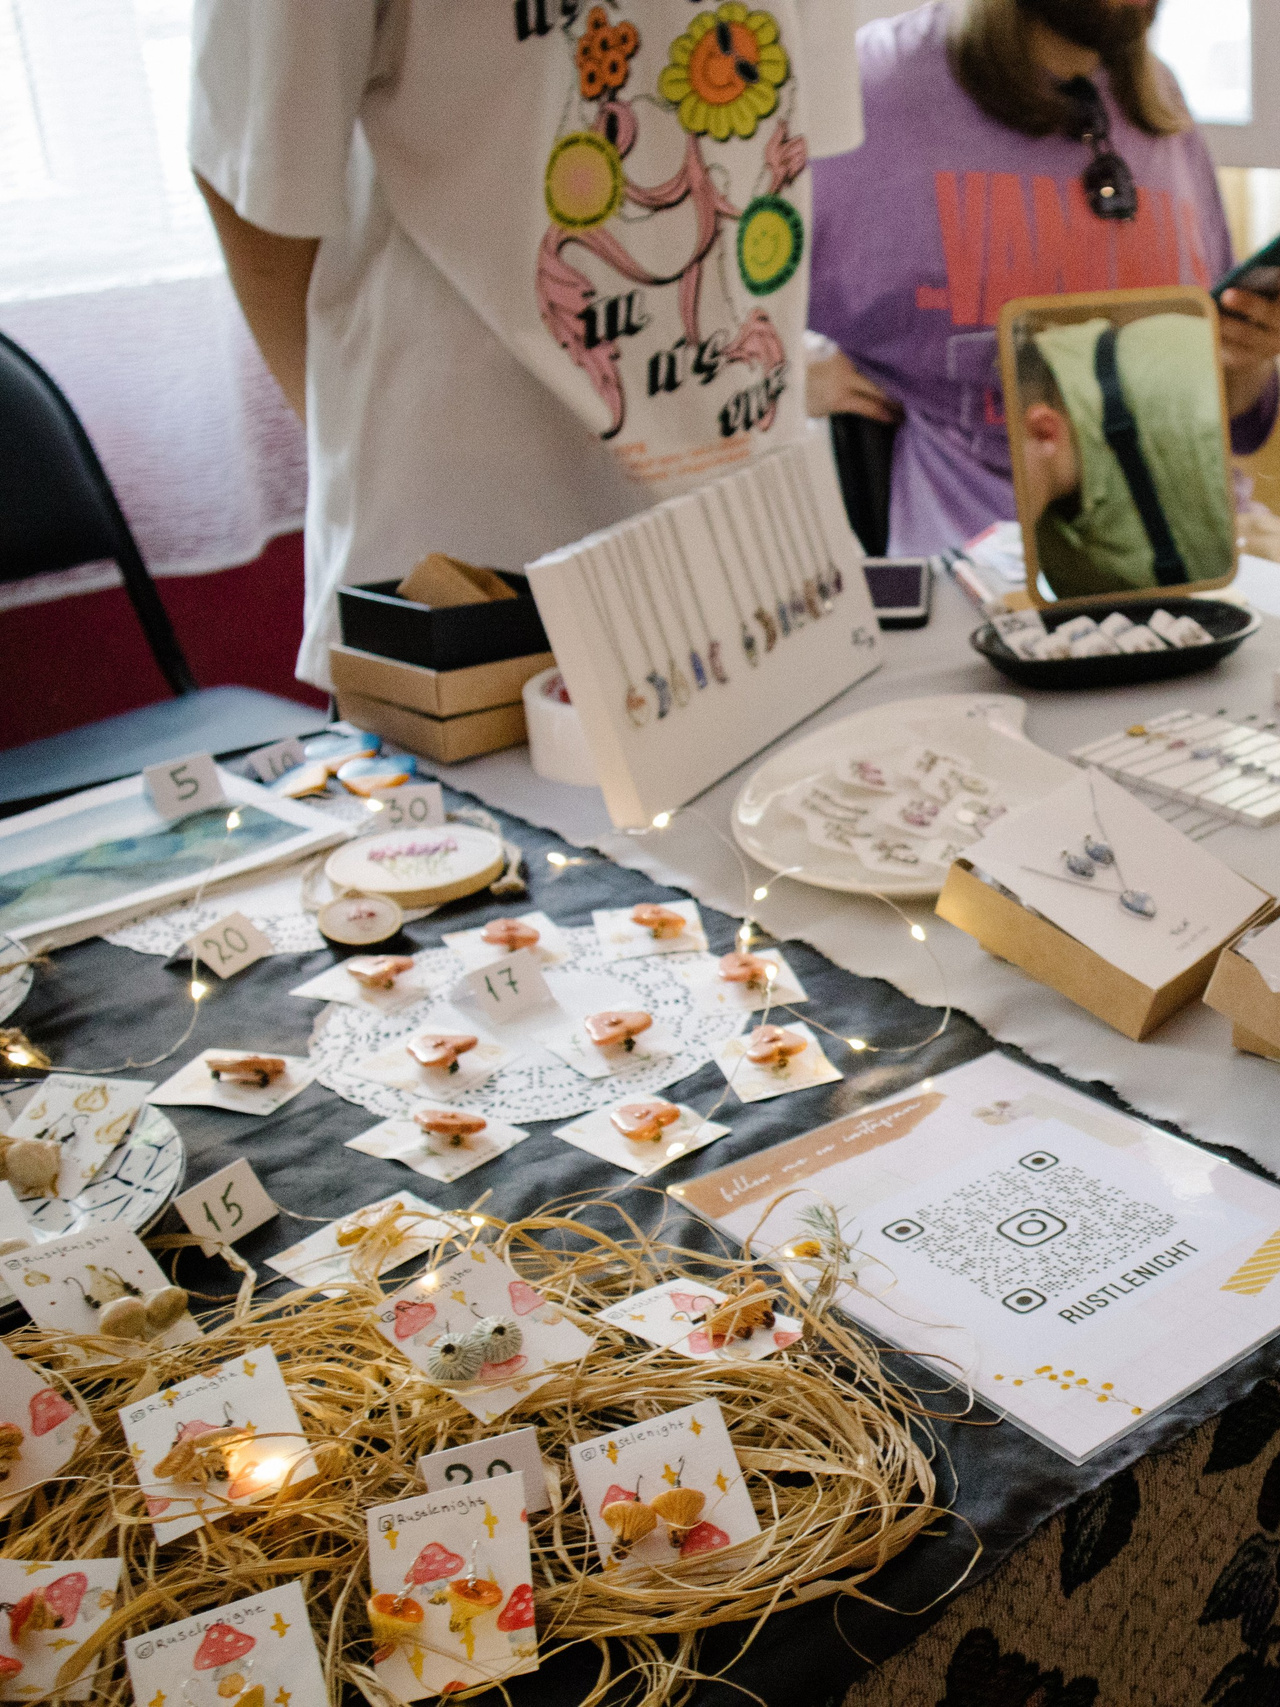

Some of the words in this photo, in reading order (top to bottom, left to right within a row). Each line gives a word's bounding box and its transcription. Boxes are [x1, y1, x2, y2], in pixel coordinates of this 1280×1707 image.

[169, 765, 199, 800] 5
[388, 796, 428, 824] 30
[203, 926, 248, 964] 20
[484, 966, 518, 1002] 17
[202, 1181, 243, 1232] 15
[1058, 1239, 1199, 1325] RUSTLENIGHT
